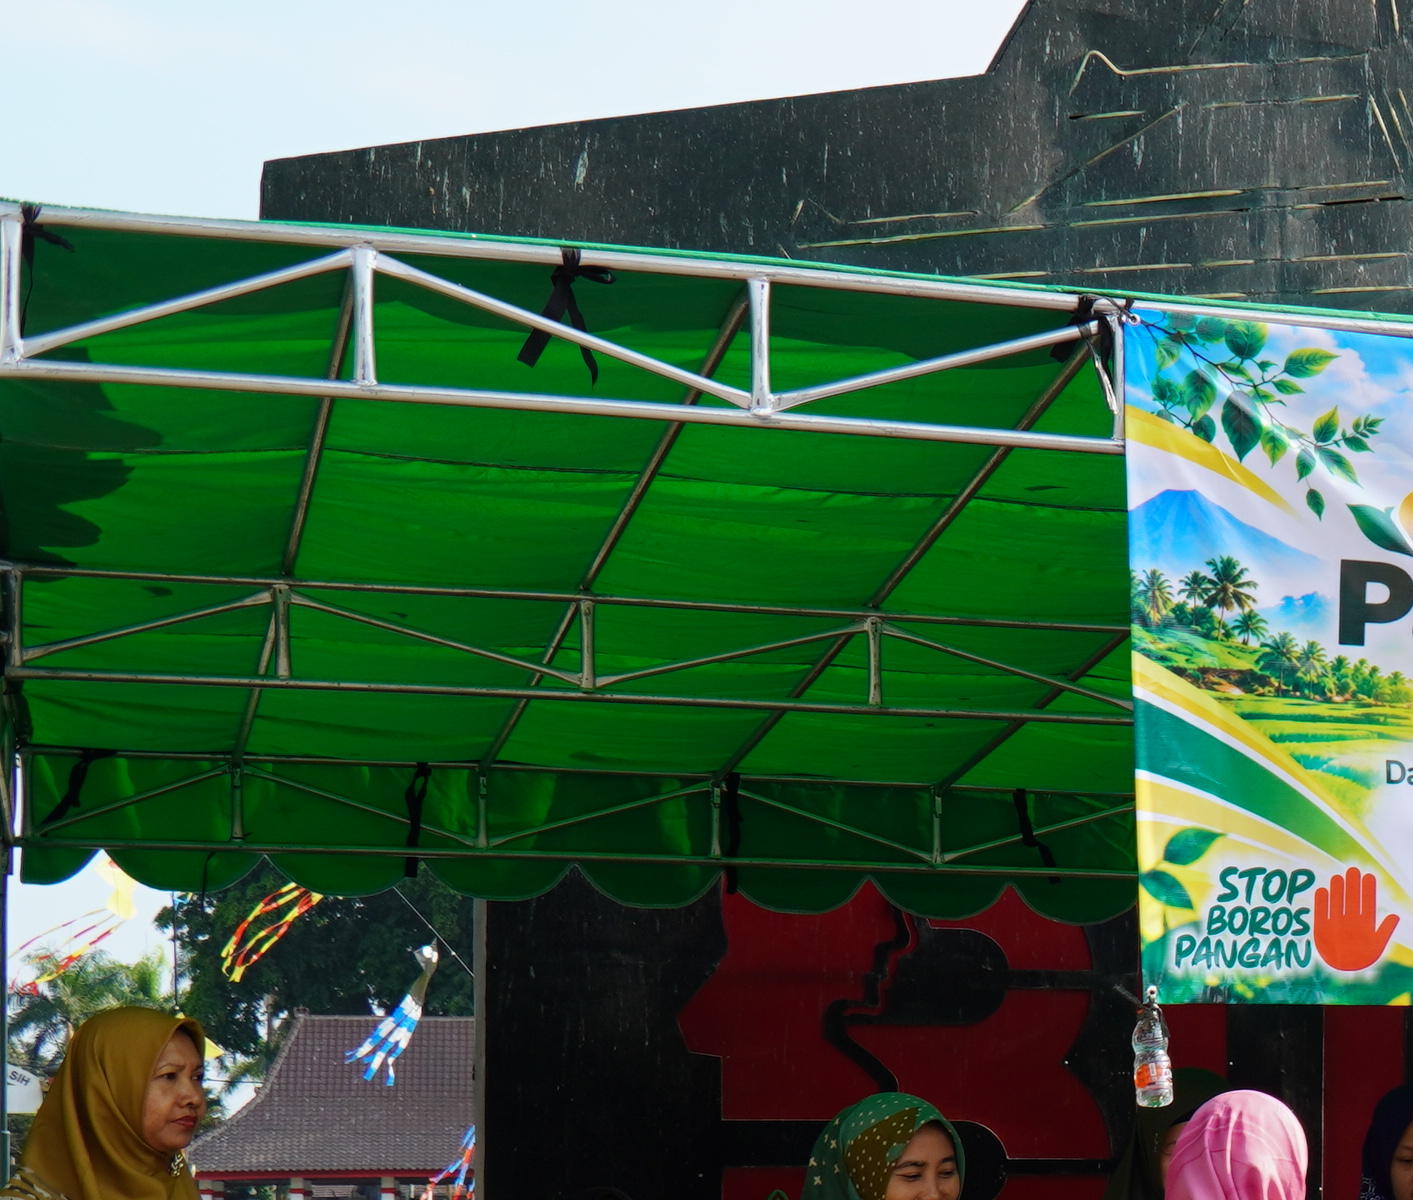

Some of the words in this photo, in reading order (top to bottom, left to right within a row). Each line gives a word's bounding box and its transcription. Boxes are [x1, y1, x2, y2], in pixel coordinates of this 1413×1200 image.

[1217, 866, 1316, 906] STOP
[1206, 905, 1311, 938] BOROS
[1174, 936, 1313, 973] PANGAN
